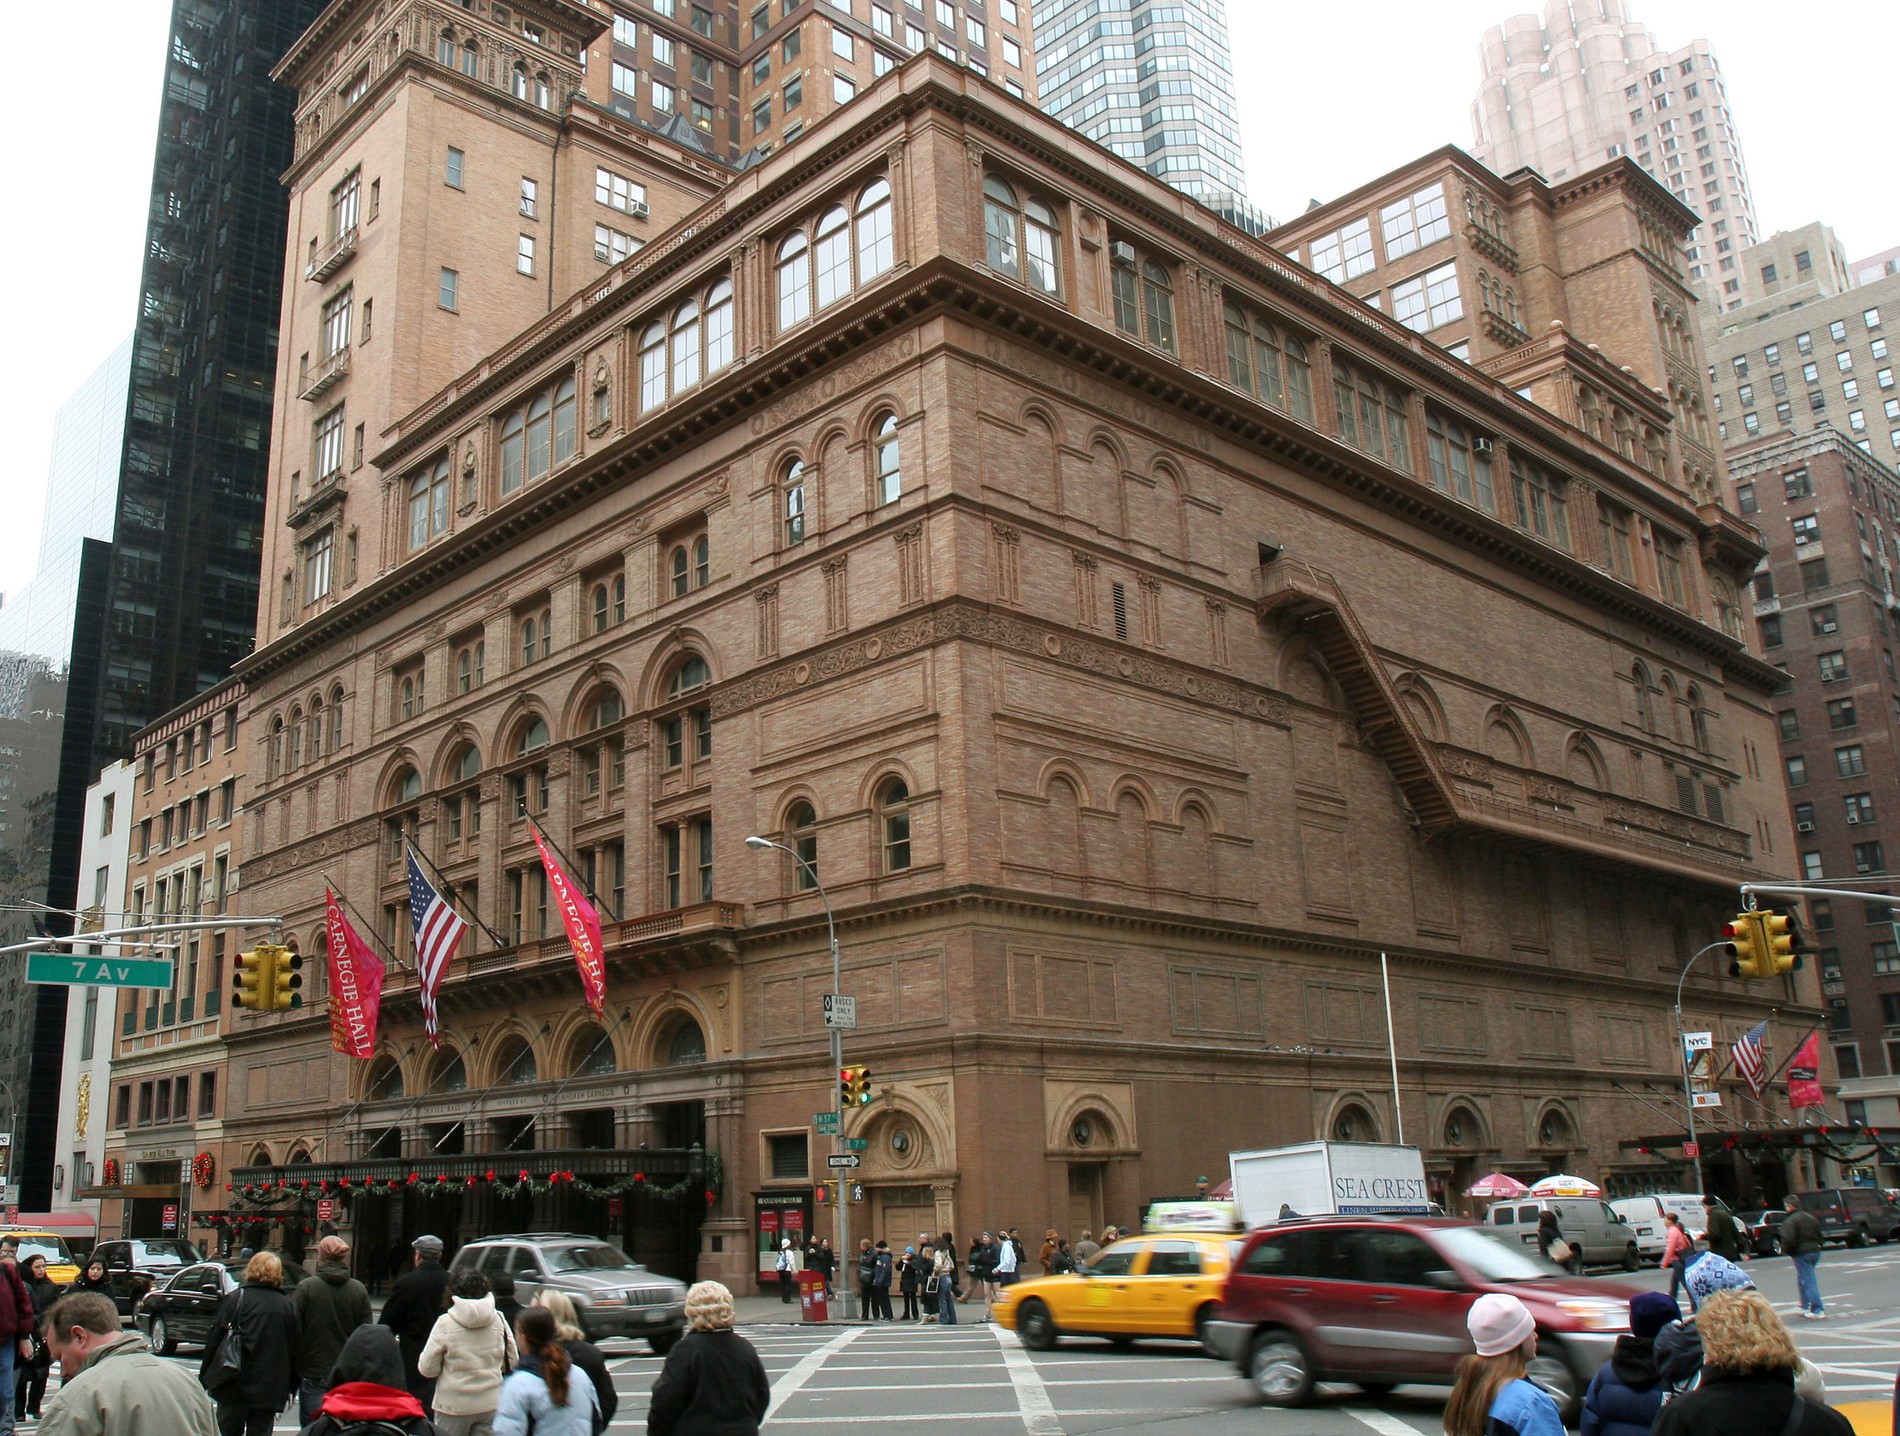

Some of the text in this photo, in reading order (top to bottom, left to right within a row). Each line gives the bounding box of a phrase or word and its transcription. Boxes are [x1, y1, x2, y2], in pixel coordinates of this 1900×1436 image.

[72, 961, 130, 981] 7 Av
[328, 904, 360, 1004] CARNEGIE
[346, 1004, 372, 1055] HALL
[834, 997, 853, 1006] BUSES
[836, 1007, 851, 1015] ONLY
[1688, 1037, 1708, 1047] NYC
[823, 1113, 831, 1123] 57
[1335, 1177, 1425, 1200] SEA CREST
[1341, 1206, 1368, 1215] LINEN
